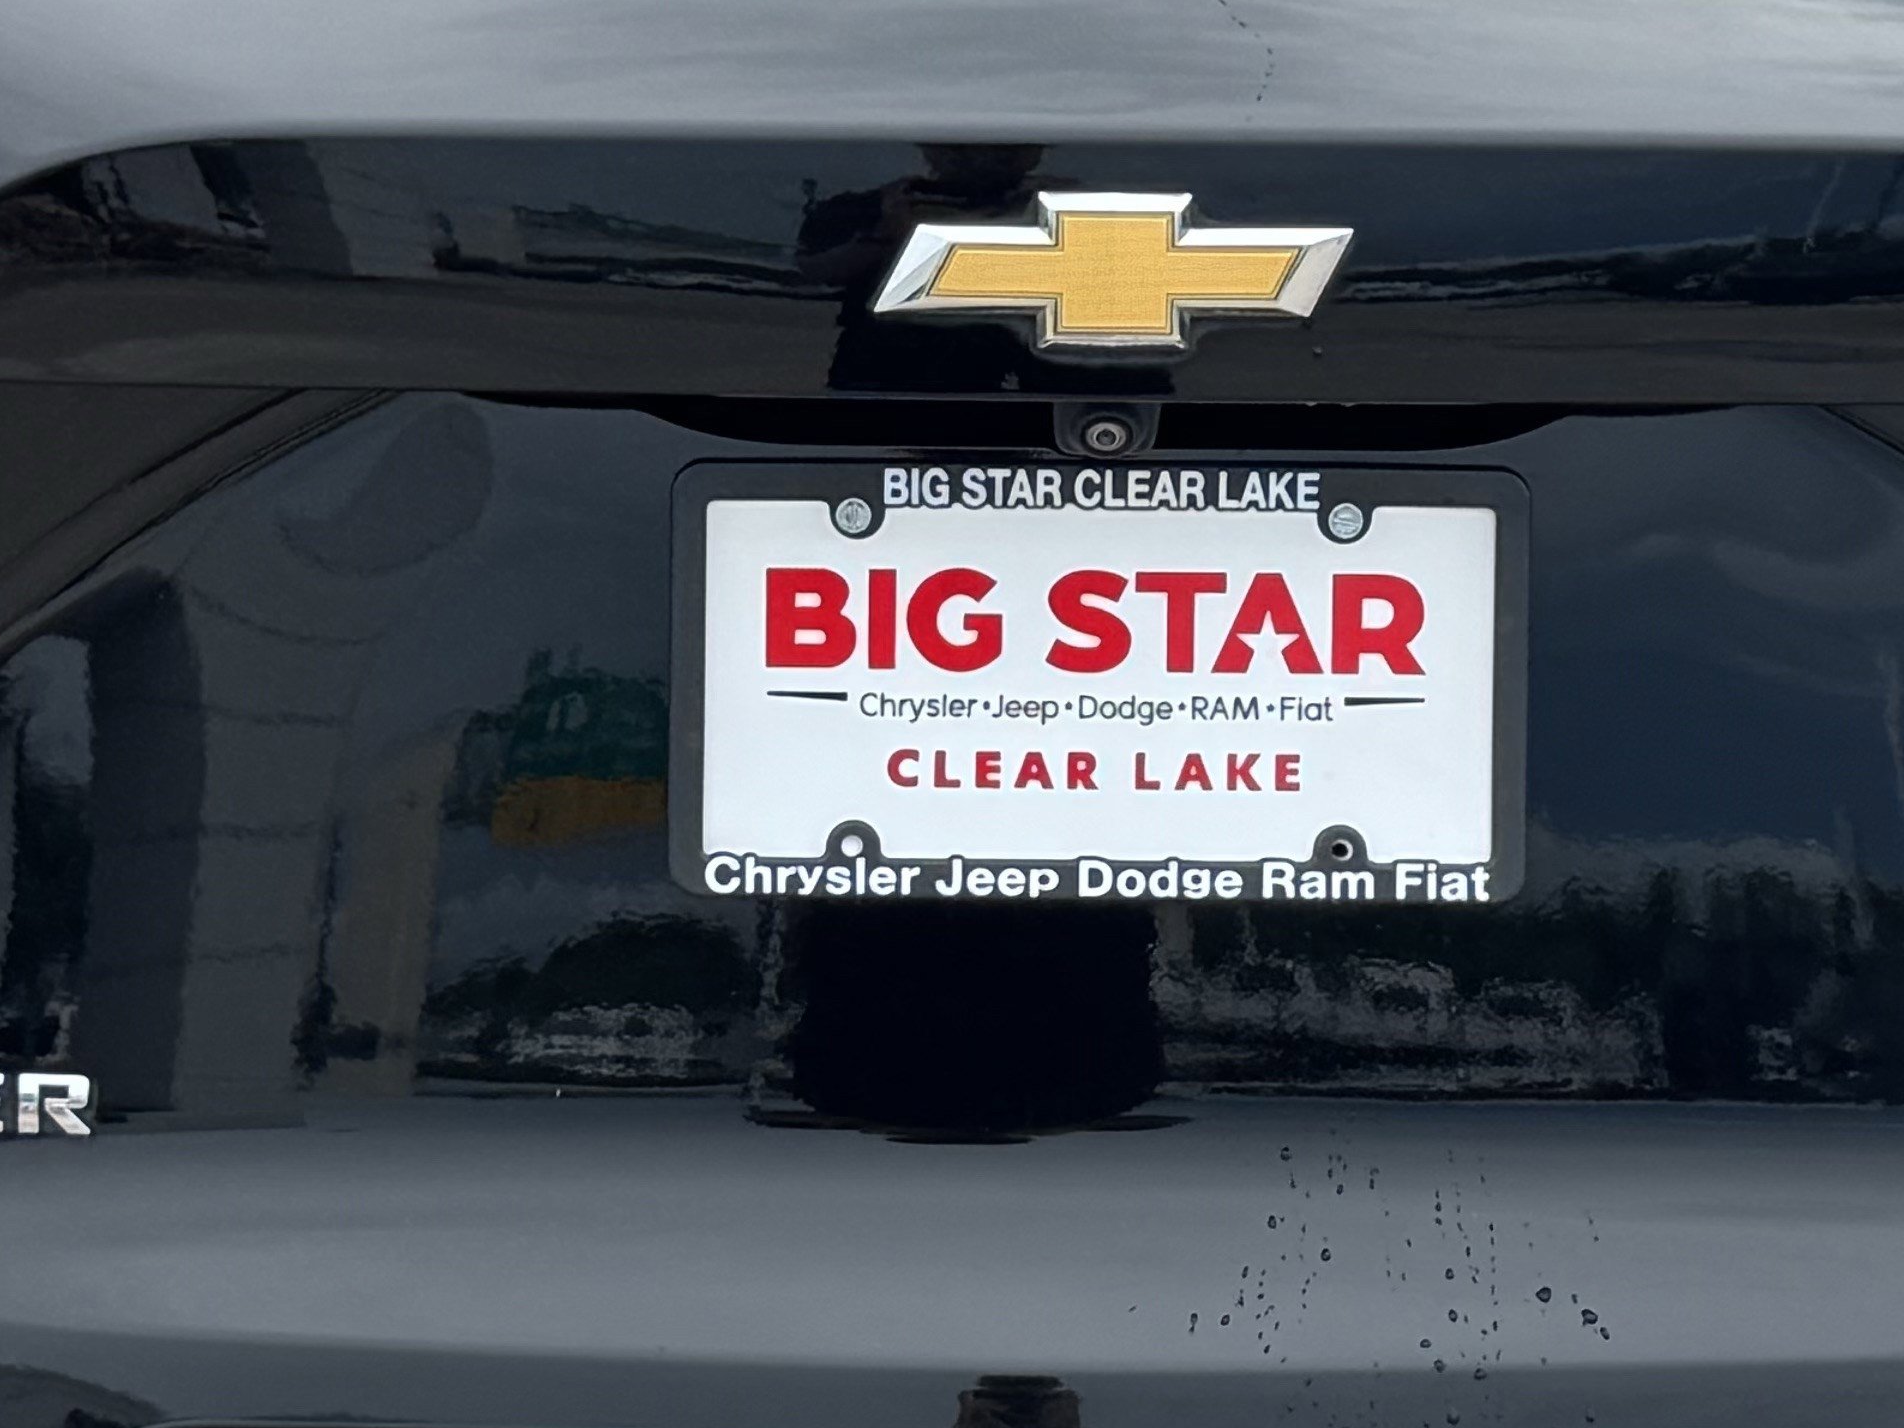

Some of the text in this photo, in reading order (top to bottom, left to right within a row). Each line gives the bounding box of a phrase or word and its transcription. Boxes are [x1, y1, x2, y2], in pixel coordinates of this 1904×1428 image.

[883, 467, 1321, 510] BIG STAR CLEAR LAKE
[764, 567, 1427, 676] BIG STAR
[887, 749, 1301, 792] CLEAR LAKE
[704, 855, 1490, 903] Chrysler Jeep Dodge Ram Fiat
